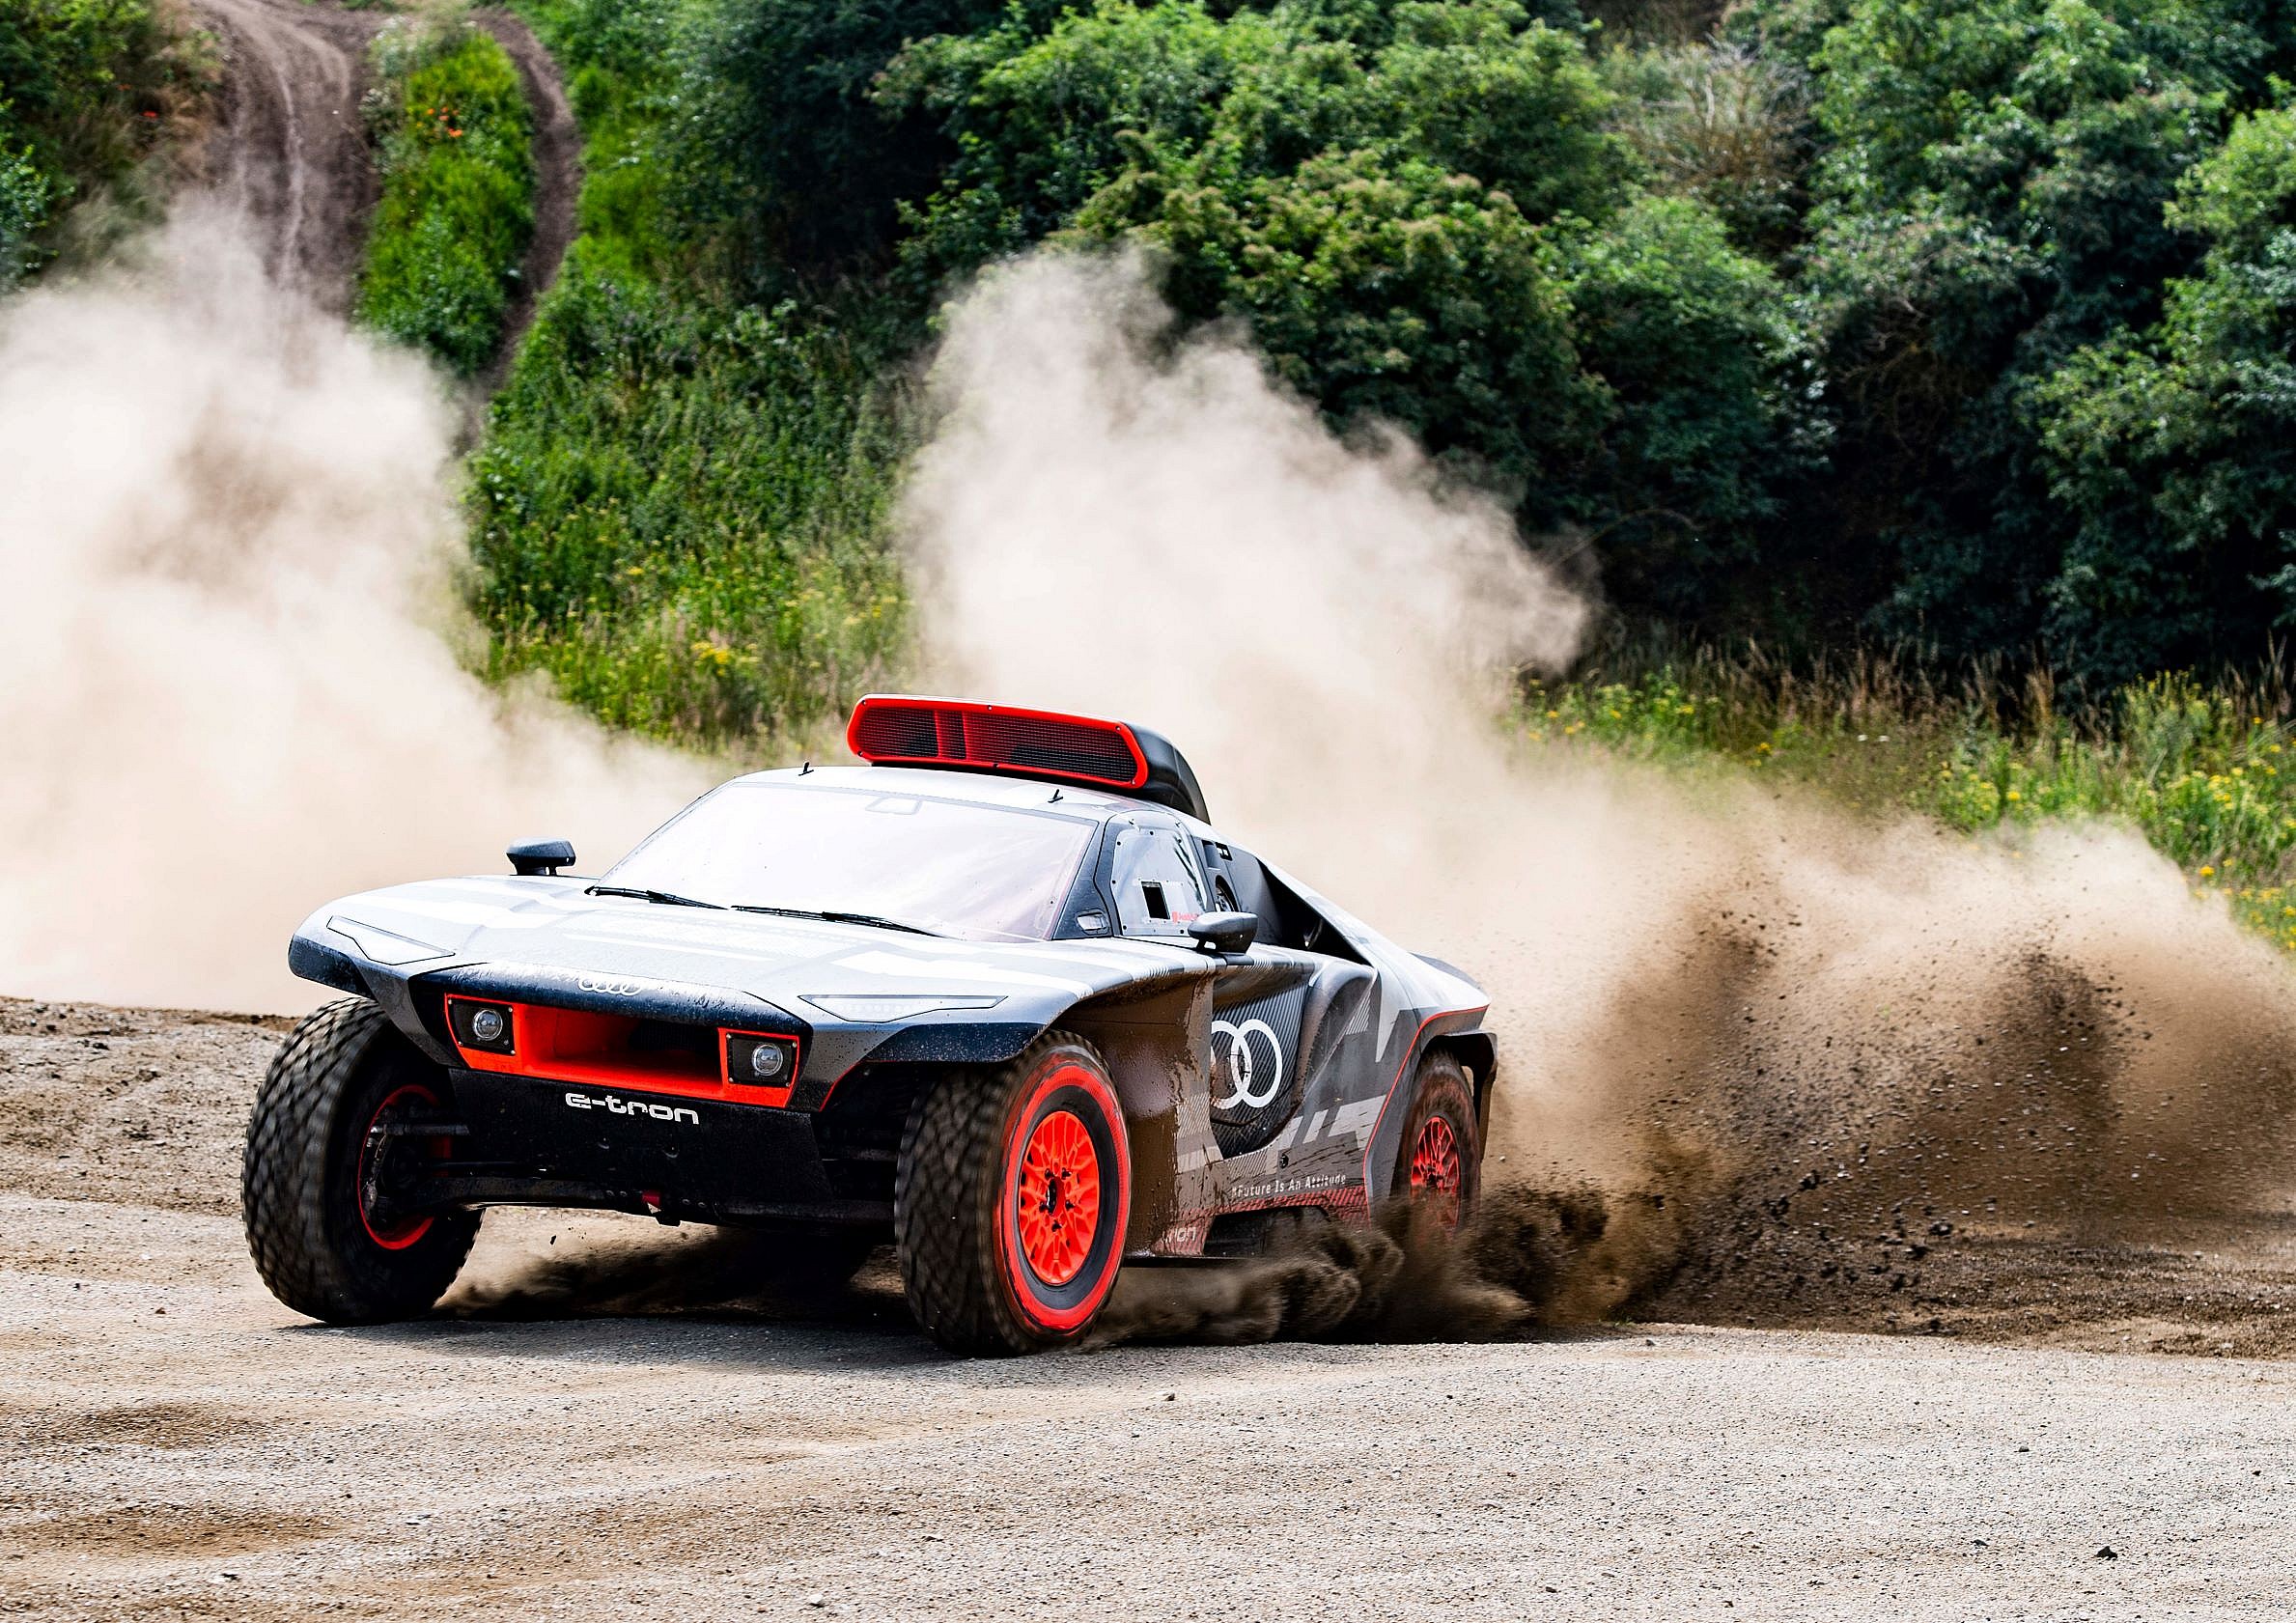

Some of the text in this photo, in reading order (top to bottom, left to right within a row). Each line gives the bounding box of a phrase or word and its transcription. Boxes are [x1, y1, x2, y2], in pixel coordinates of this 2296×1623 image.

[565, 1092, 700, 1125] e-tron
[1274, 1179, 1285, 1193] Is
[1287, 1178, 1302, 1191] An
[1304, 1173, 1346, 1189] Attitude
